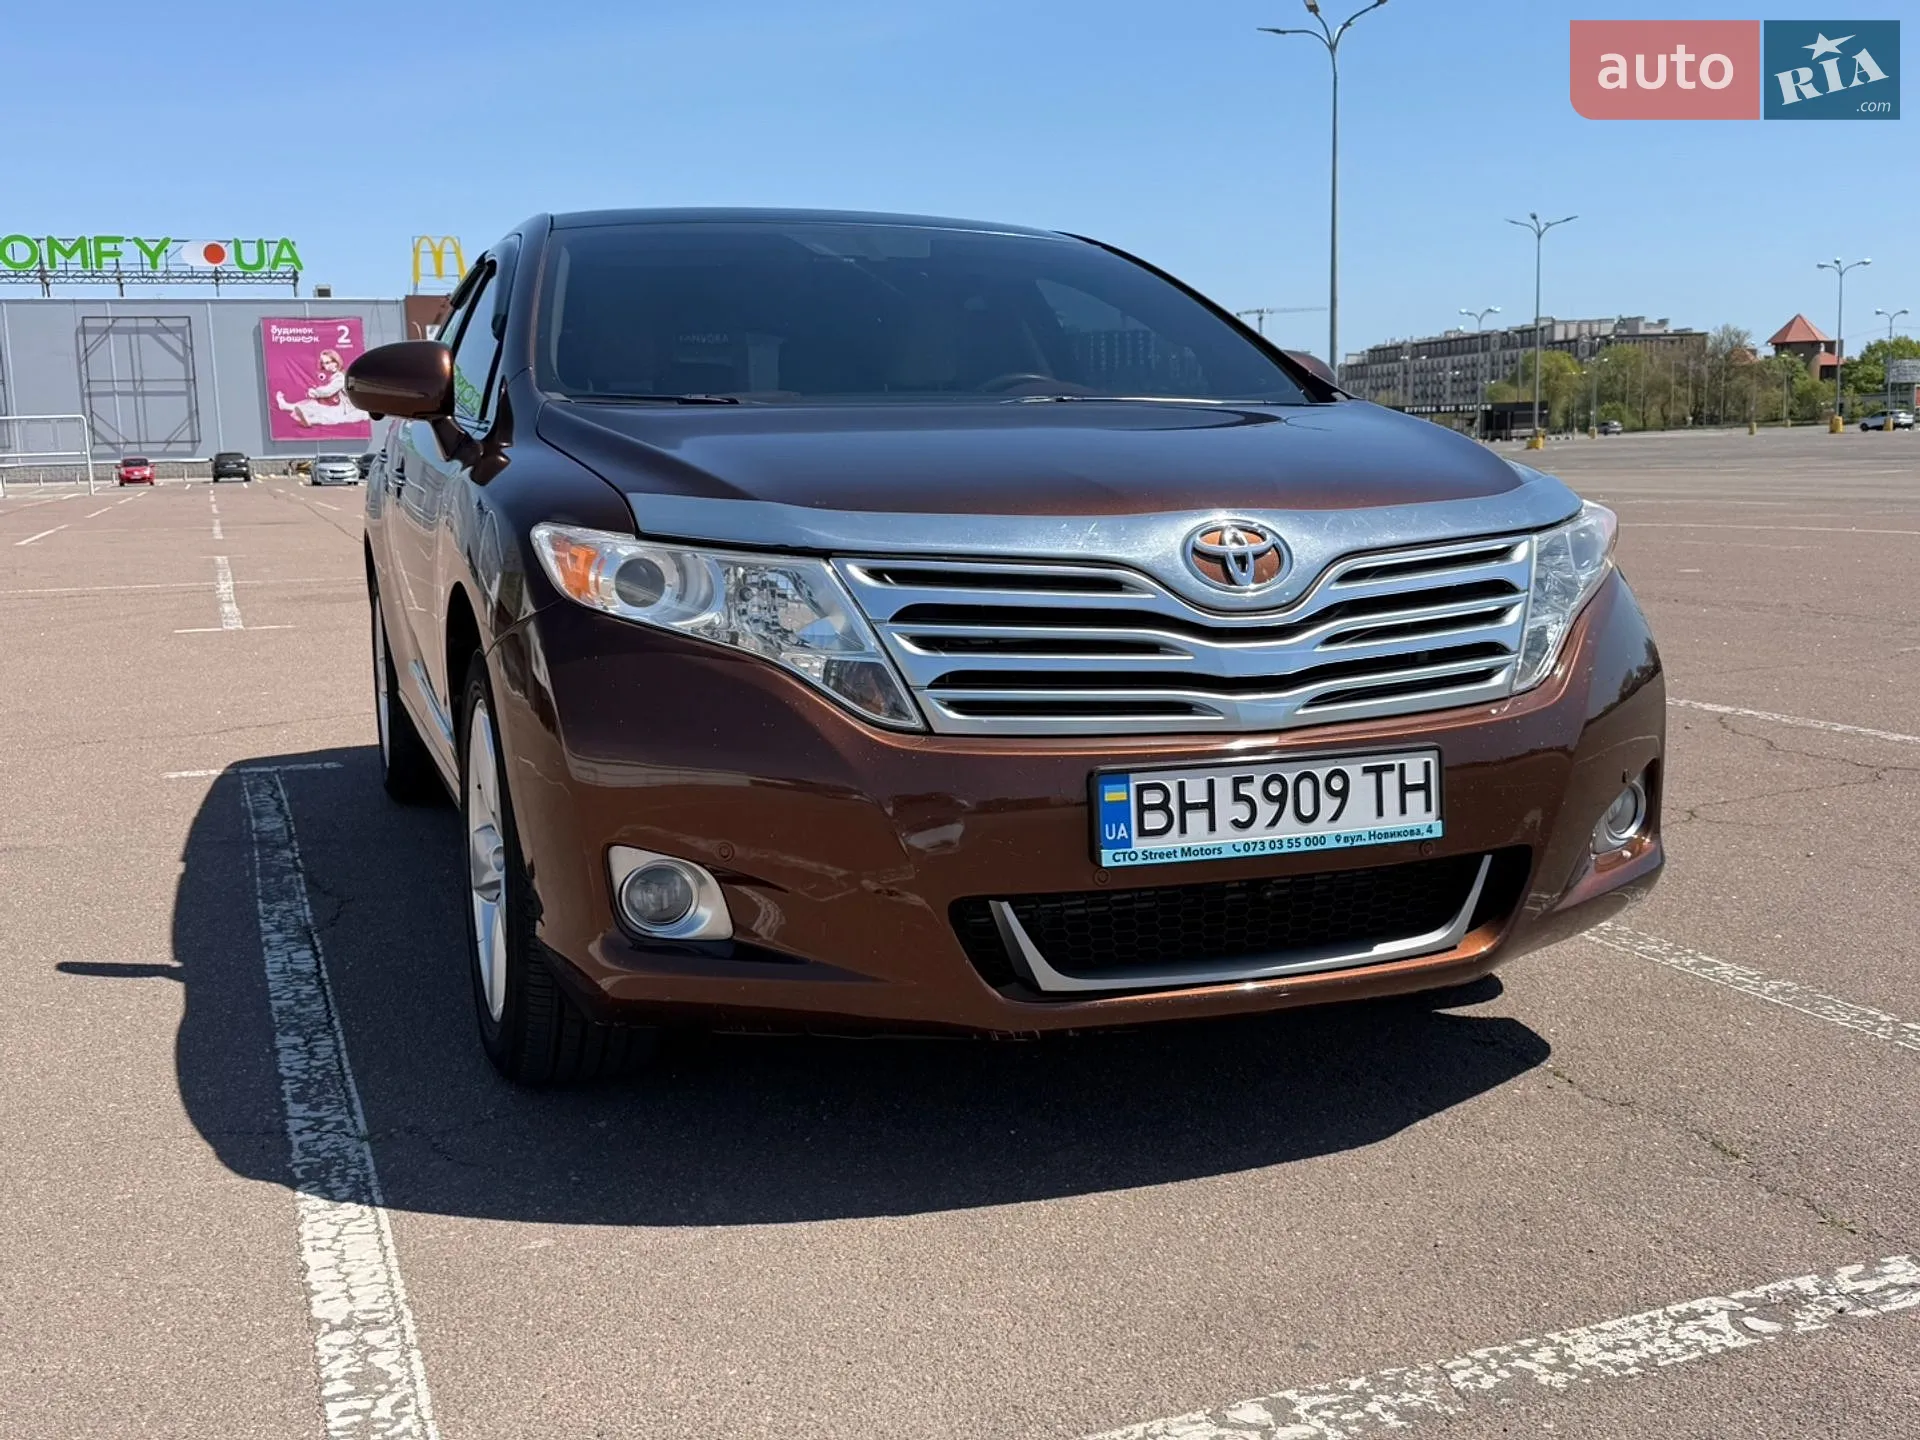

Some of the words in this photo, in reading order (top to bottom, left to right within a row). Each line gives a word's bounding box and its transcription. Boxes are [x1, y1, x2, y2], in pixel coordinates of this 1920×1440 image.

[232, 237, 304, 272] UA
[337, 325, 351, 343] 2
[1459, 404, 1492, 412] STATON
[1135, 778, 1217, 838] BH
[1229, 768, 1351, 830] 5909
[1362, 760, 1433, 818] TH
[1105, 823, 1128, 840] UA
[1141, 847, 1178, 861] Street
[1181, 845, 1223, 859] Motors
[1243, 839, 1267, 853] 073
[1269, 838, 1284, 850] 03
[1287, 837, 1302, 849] 55
[1304, 835, 1327, 848] 000
[1343, 832, 1365, 846] вул.
[1426, 825, 1434, 835] 4
